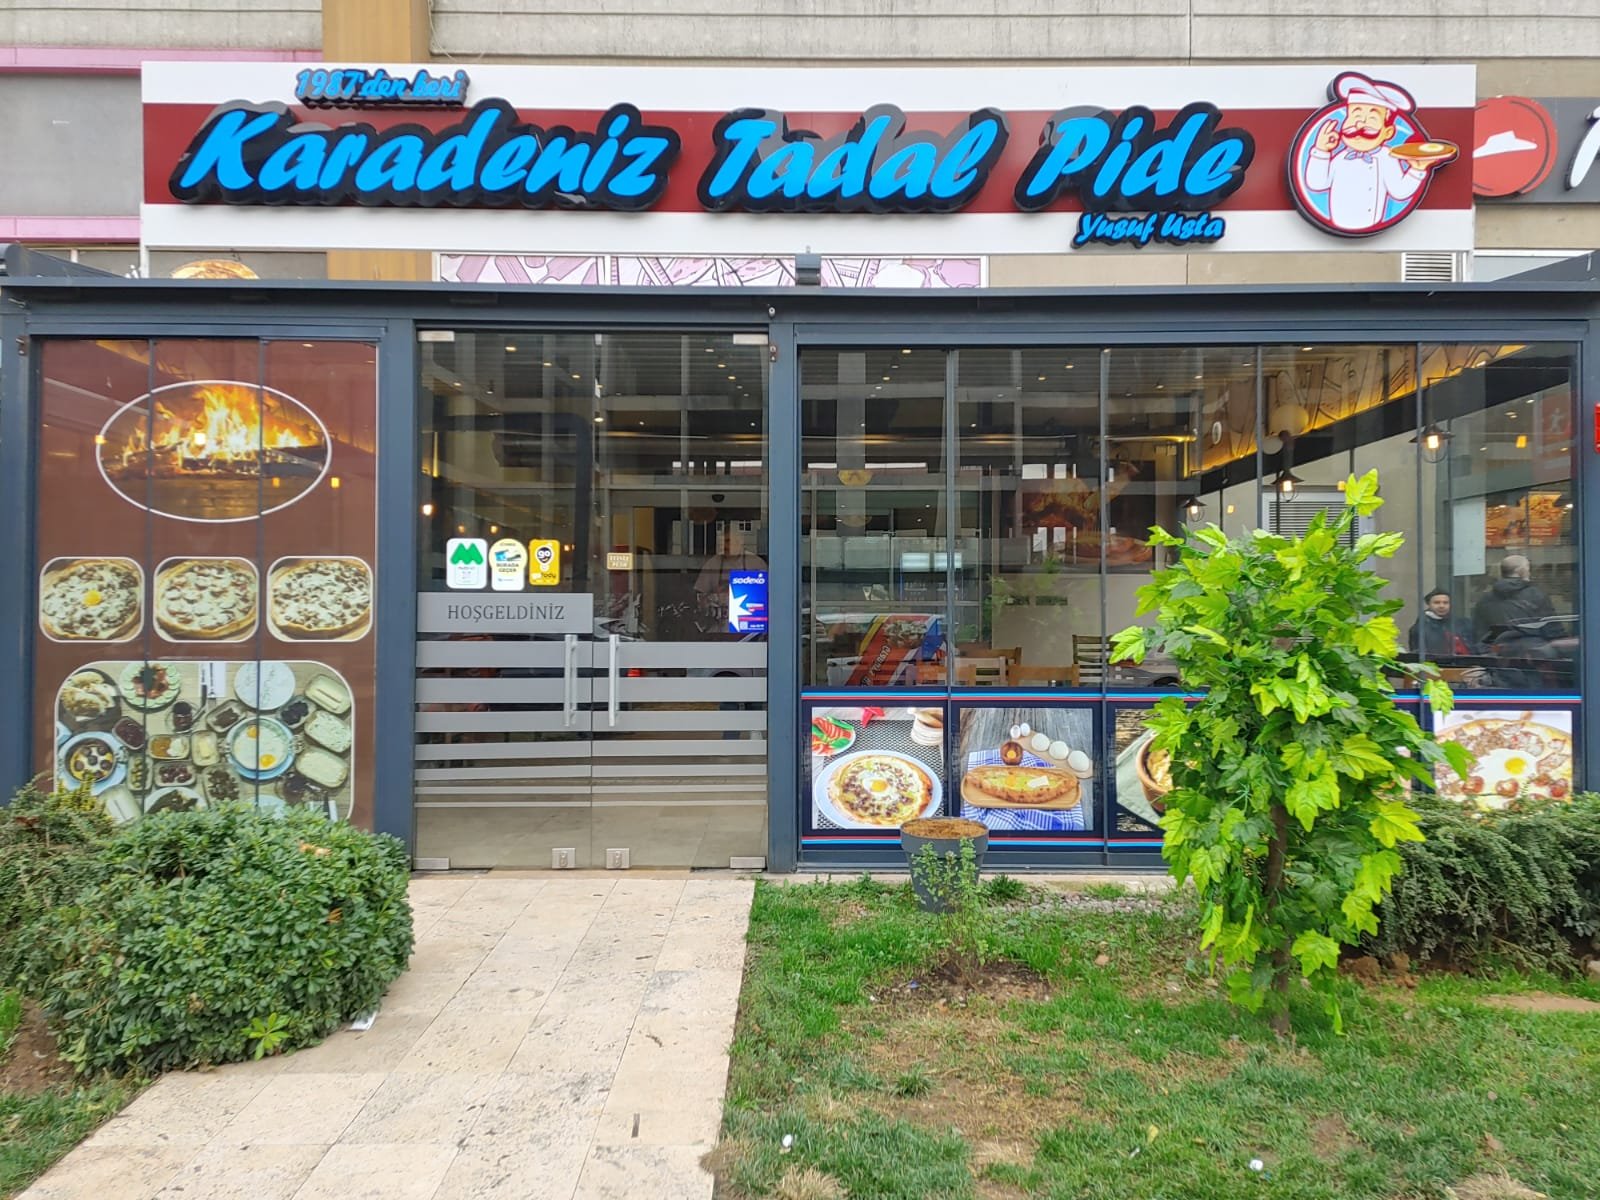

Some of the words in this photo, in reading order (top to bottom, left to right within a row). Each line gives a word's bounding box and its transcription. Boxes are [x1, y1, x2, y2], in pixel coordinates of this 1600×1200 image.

[296, 70, 408, 98] 1987'den
[409, 71, 464, 98] beri
[179, 108, 669, 197] Karadeniz
[708, 116, 999, 200] Tadal
[1026, 112, 1244, 199] Pide
[1076, 212, 1158, 243] Yusuf
[1160, 212, 1224, 241] Usta
[448, 602, 565, 623] HOŞGELDİNİZ
